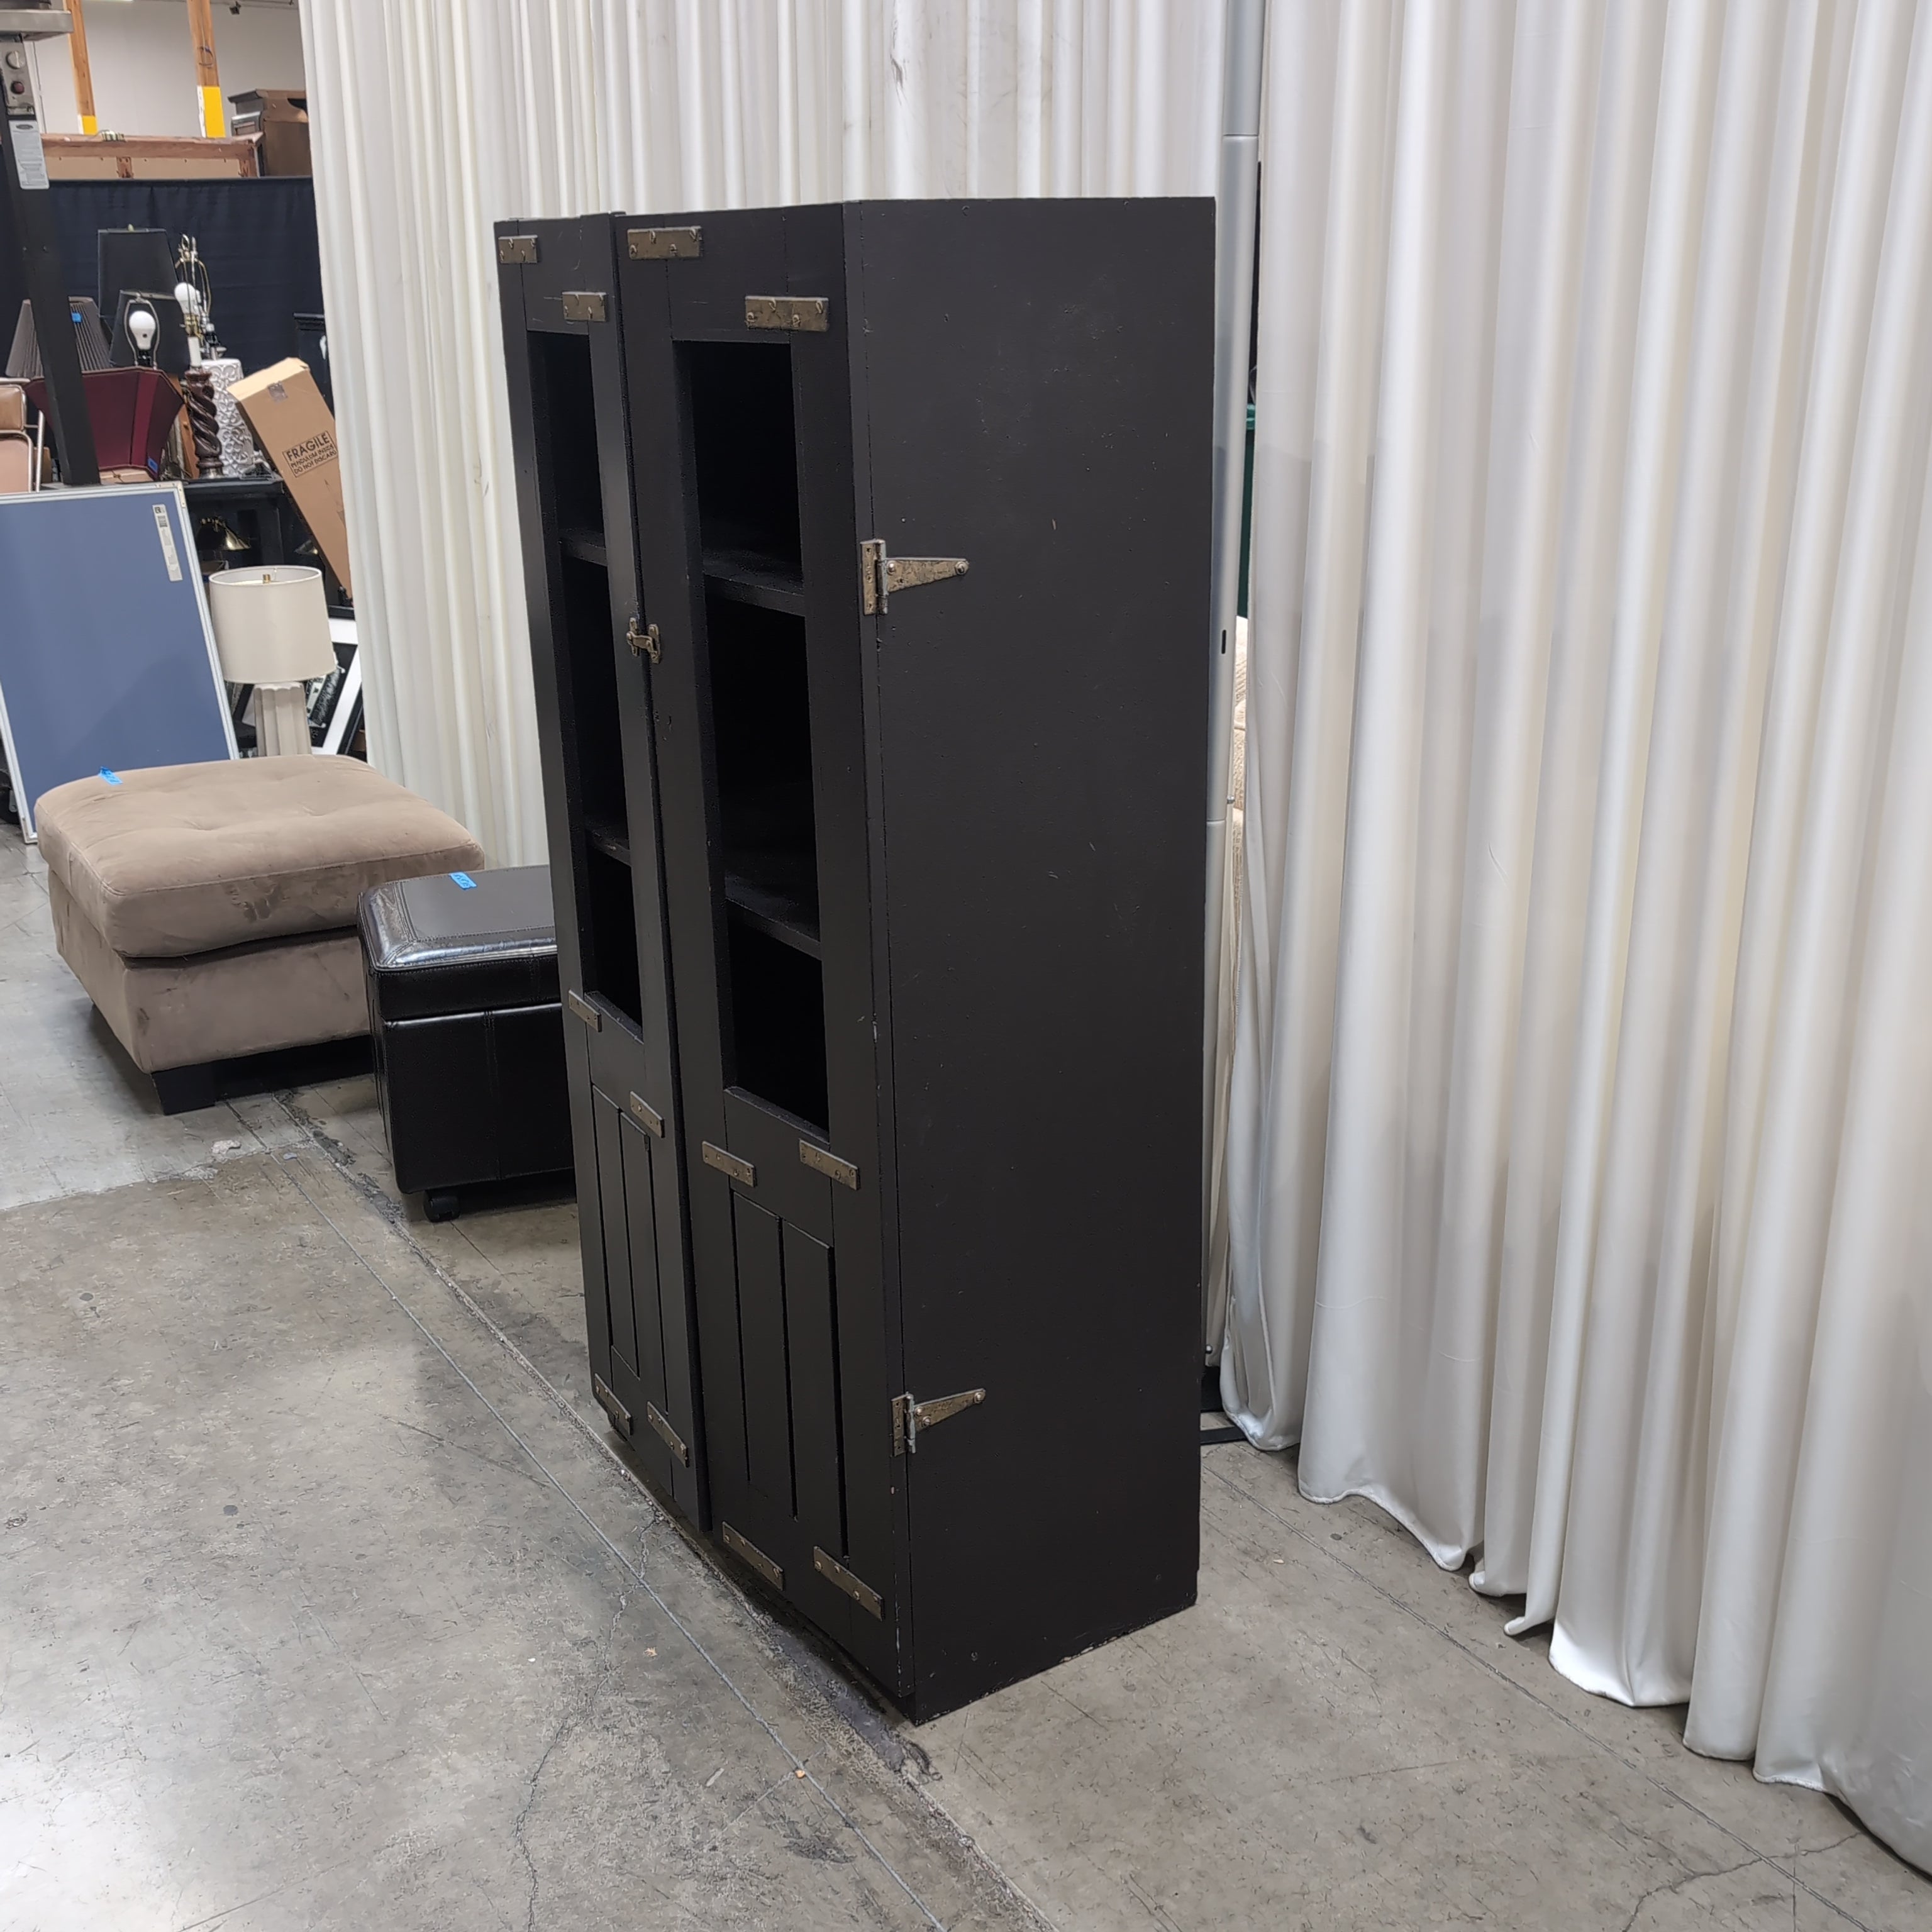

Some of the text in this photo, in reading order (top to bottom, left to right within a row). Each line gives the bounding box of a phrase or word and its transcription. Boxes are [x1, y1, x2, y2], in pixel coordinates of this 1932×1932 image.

[286, 432, 330, 461] FRAGILE
[294, 466, 303, 474] DO
[303, 460, 314, 470] NOT
